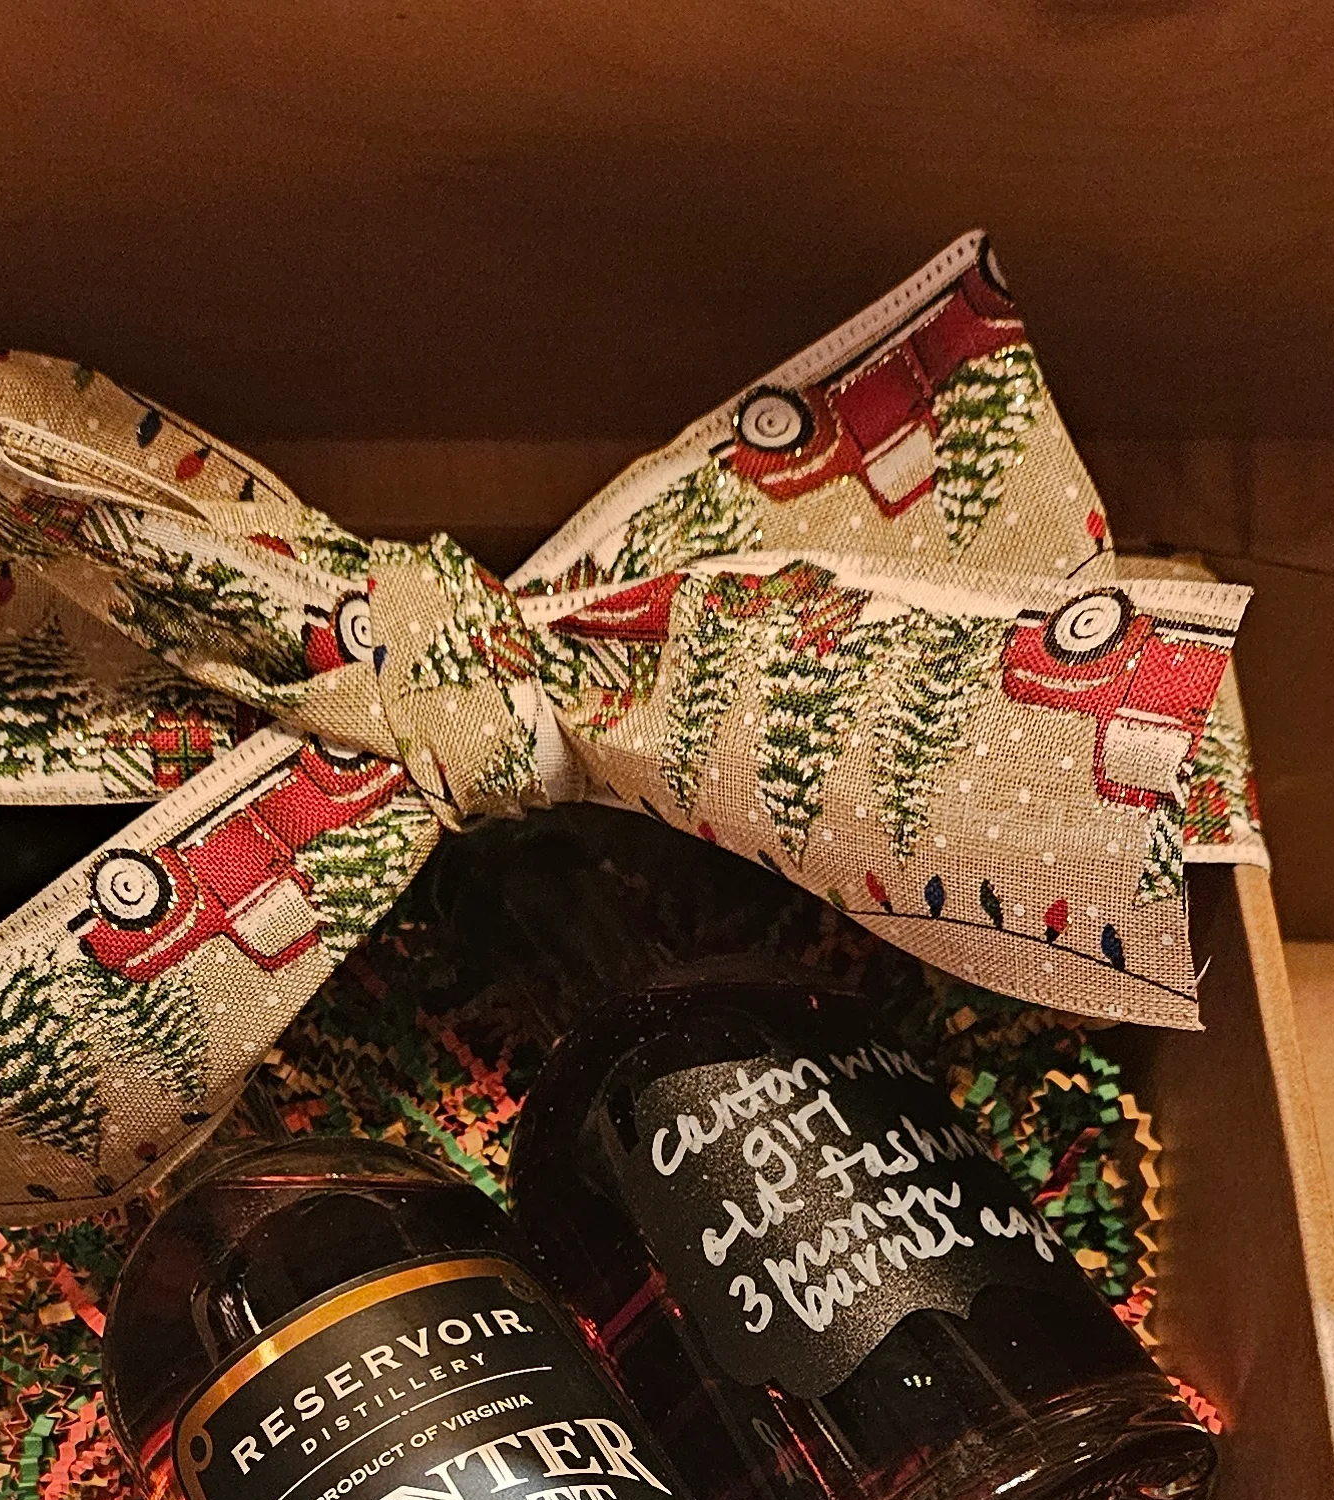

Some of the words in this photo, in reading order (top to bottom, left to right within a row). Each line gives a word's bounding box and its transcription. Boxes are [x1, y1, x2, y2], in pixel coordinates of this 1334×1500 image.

[743, 1088, 852, 1192] girl
[702, 1170, 806, 1266] old
[229, 1308, 534, 1476] RESERVOIR
[300, 1351, 488, 1457] DISTILLERY
[409, 1425, 440, 1450] OF
[440, 1393, 534, 1433] VIRGINIA
